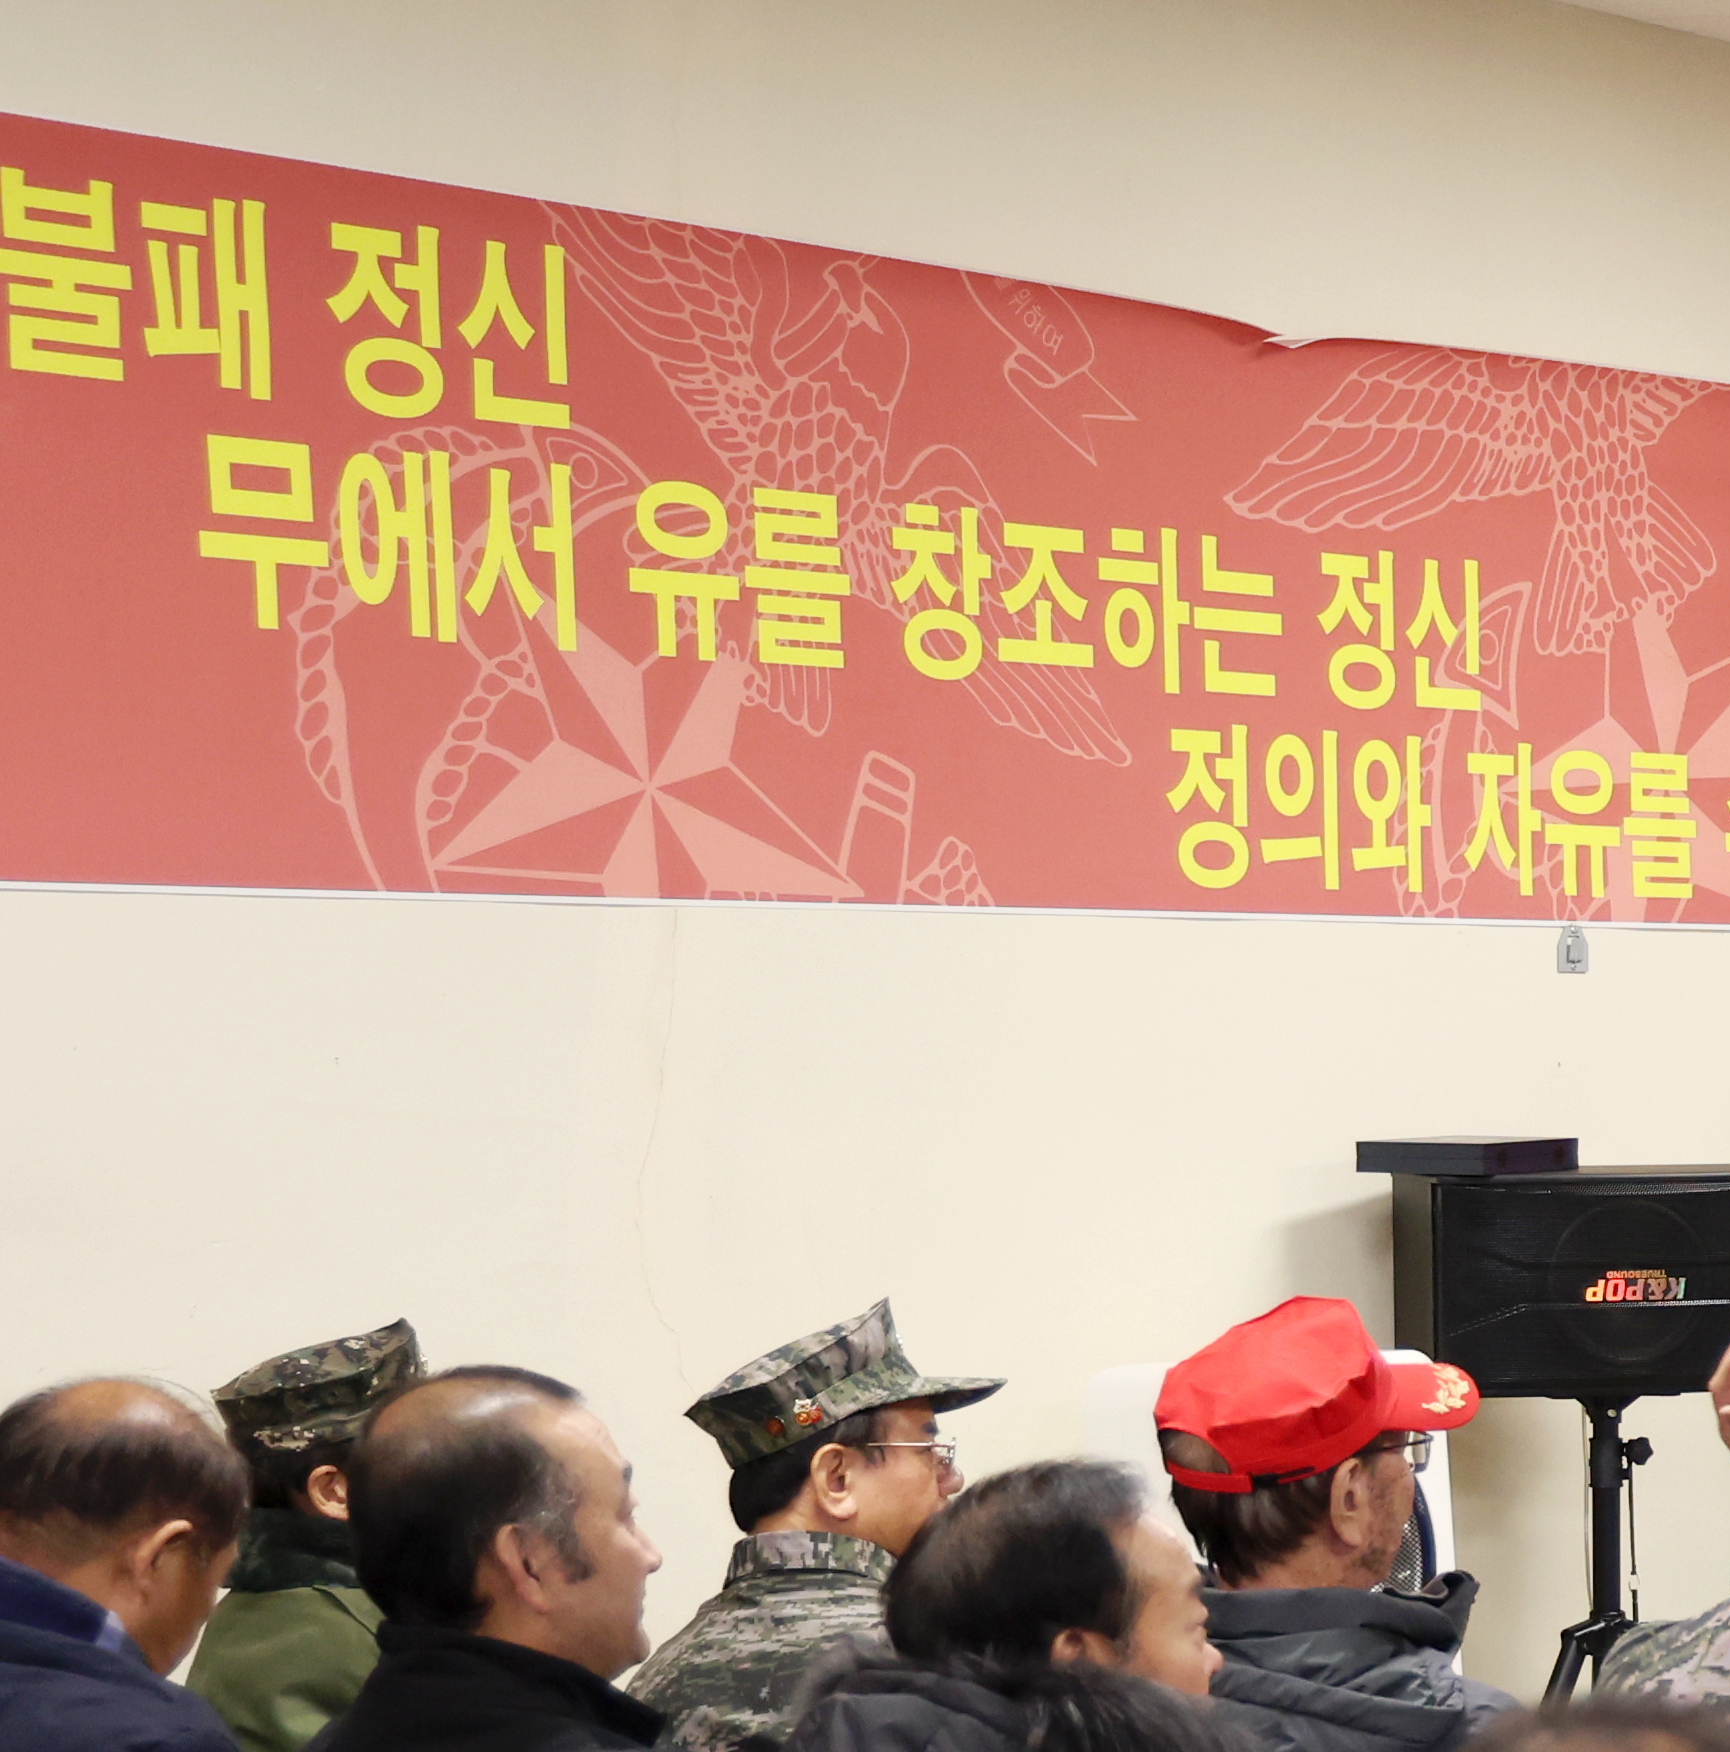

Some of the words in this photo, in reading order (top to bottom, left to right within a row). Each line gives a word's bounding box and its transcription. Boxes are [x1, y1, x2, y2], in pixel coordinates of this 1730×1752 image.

[0, 165, 272, 401] 불패
[326, 222, 571, 429] 정신
[1007, 288, 1064, 356] 위하여
[198, 433, 577, 652] 무에서
[628, 480, 851, 668] 유를
[891, 501, 1283, 696] 창조하는
[1317, 549, 1482, 712] 정신
[1166, 723, 1432, 893] 정의와
[1464, 741, 1697, 900] 자유를
